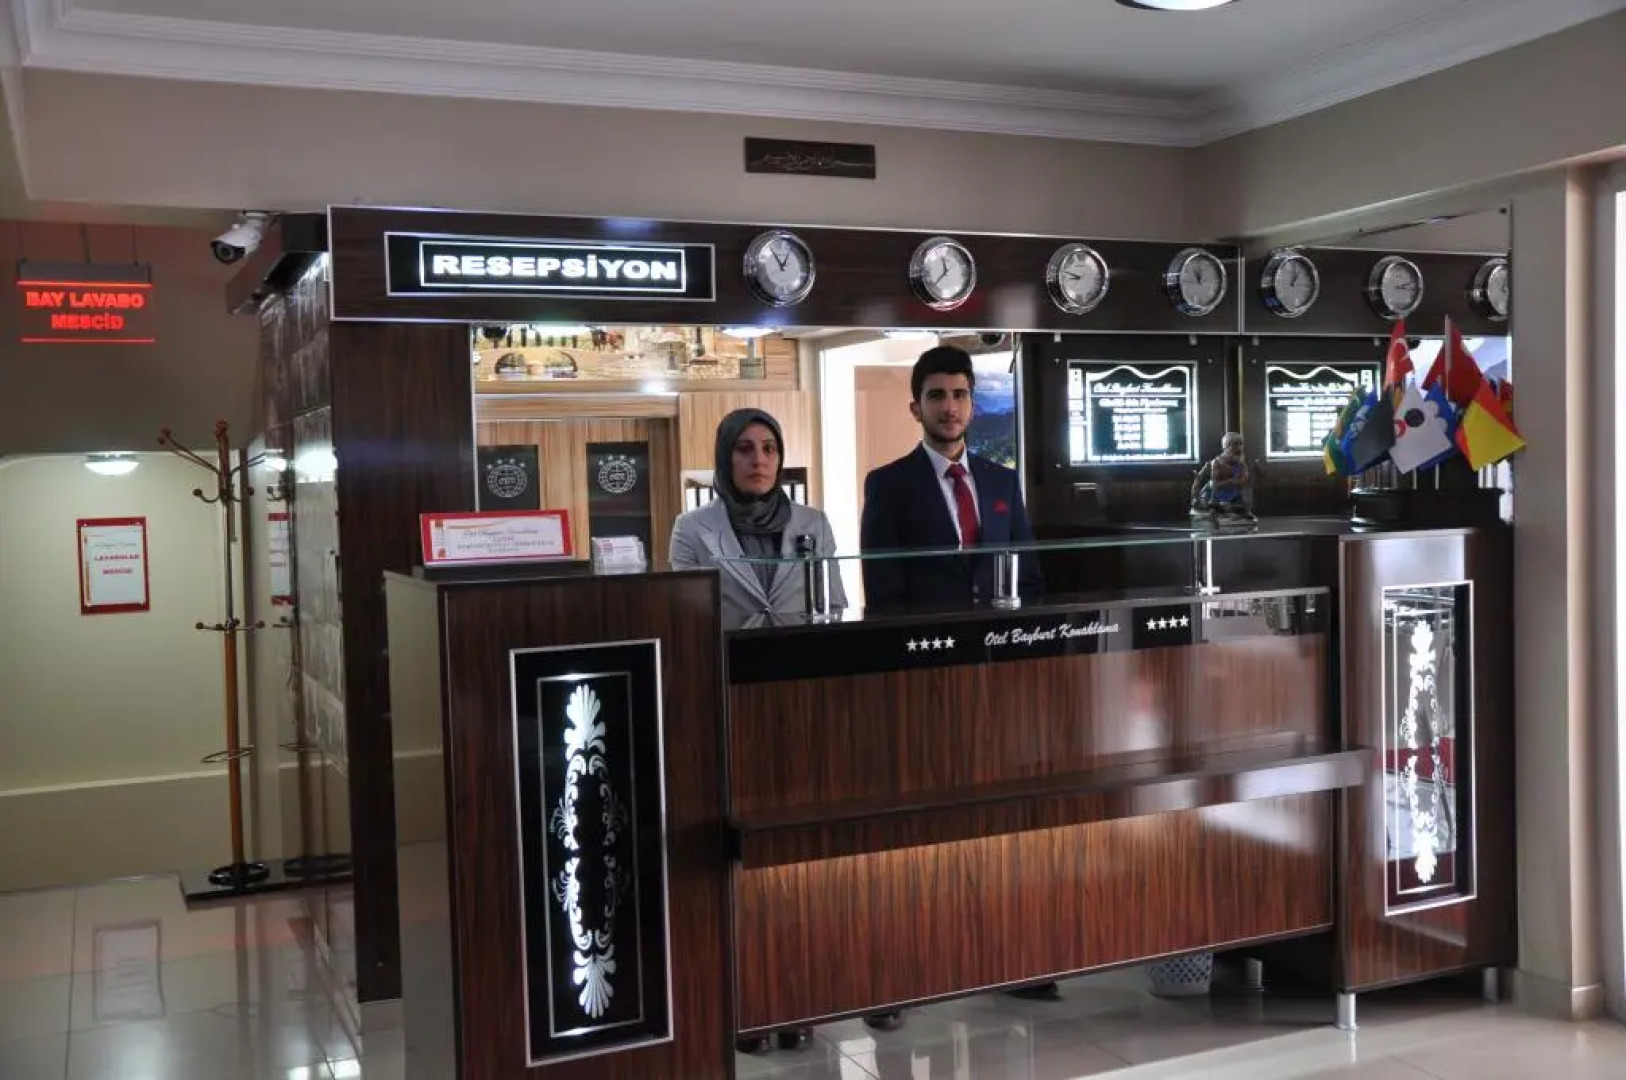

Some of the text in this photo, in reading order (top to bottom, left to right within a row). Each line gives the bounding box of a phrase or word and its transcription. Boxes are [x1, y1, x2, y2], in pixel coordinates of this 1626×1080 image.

[432, 254, 677, 281] RESEPSİYON
[26, 291, 144, 309] BAY LAVABO
[51, 312, 125, 330] MESCİD
[984, 620, 1120, 646] Otel Bayburt Konaklama
